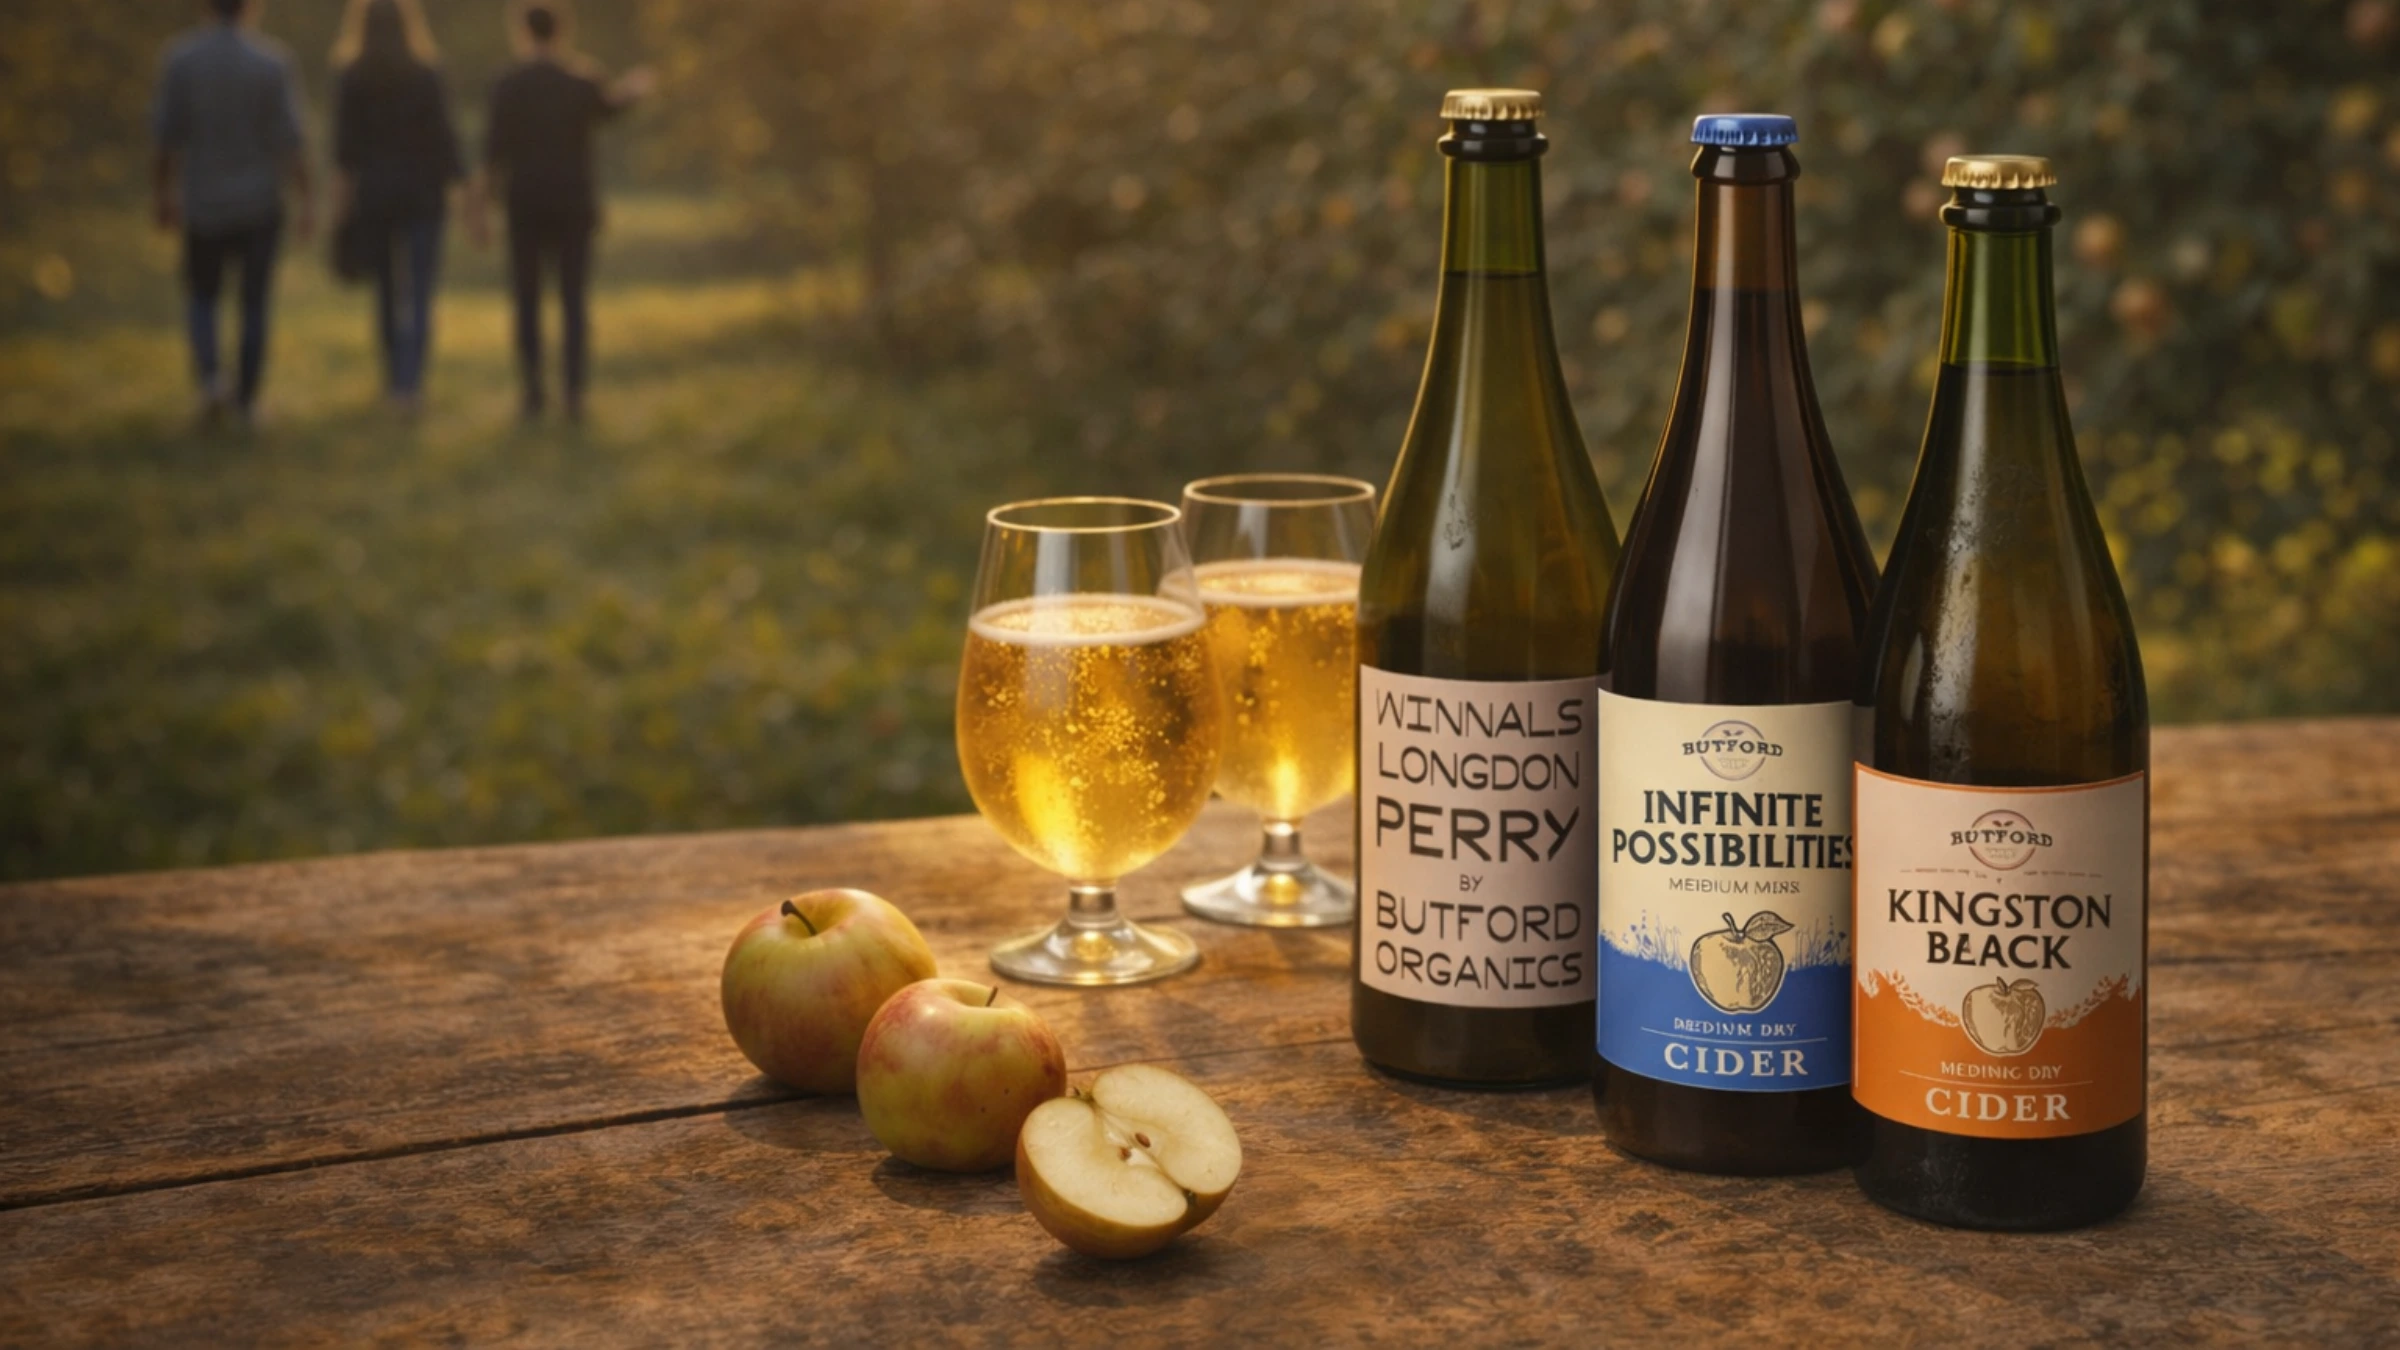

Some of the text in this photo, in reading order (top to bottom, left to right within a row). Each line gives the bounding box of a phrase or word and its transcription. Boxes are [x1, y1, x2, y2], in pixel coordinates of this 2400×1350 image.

[1376, 688, 1583, 738] WINNALS
[1379, 742, 1580, 791] LONGDON
[1682, 739, 1783, 757] BUTFORD
[1643, 790, 1823, 827] INFINITE
[1376, 795, 1580, 862] PERRY
[1951, 830, 2053, 847] BUTFORD
[1459, 874, 1483, 892] BY
[1376, 890, 1581, 942] BUTFORD
[1888, 889, 2112, 929] KINGSTON
[1376, 940, 1583, 990] ORGANICS
[1664, 1043, 1808, 1076] CIDER
[1925, 1087, 2070, 1122] CIDER
